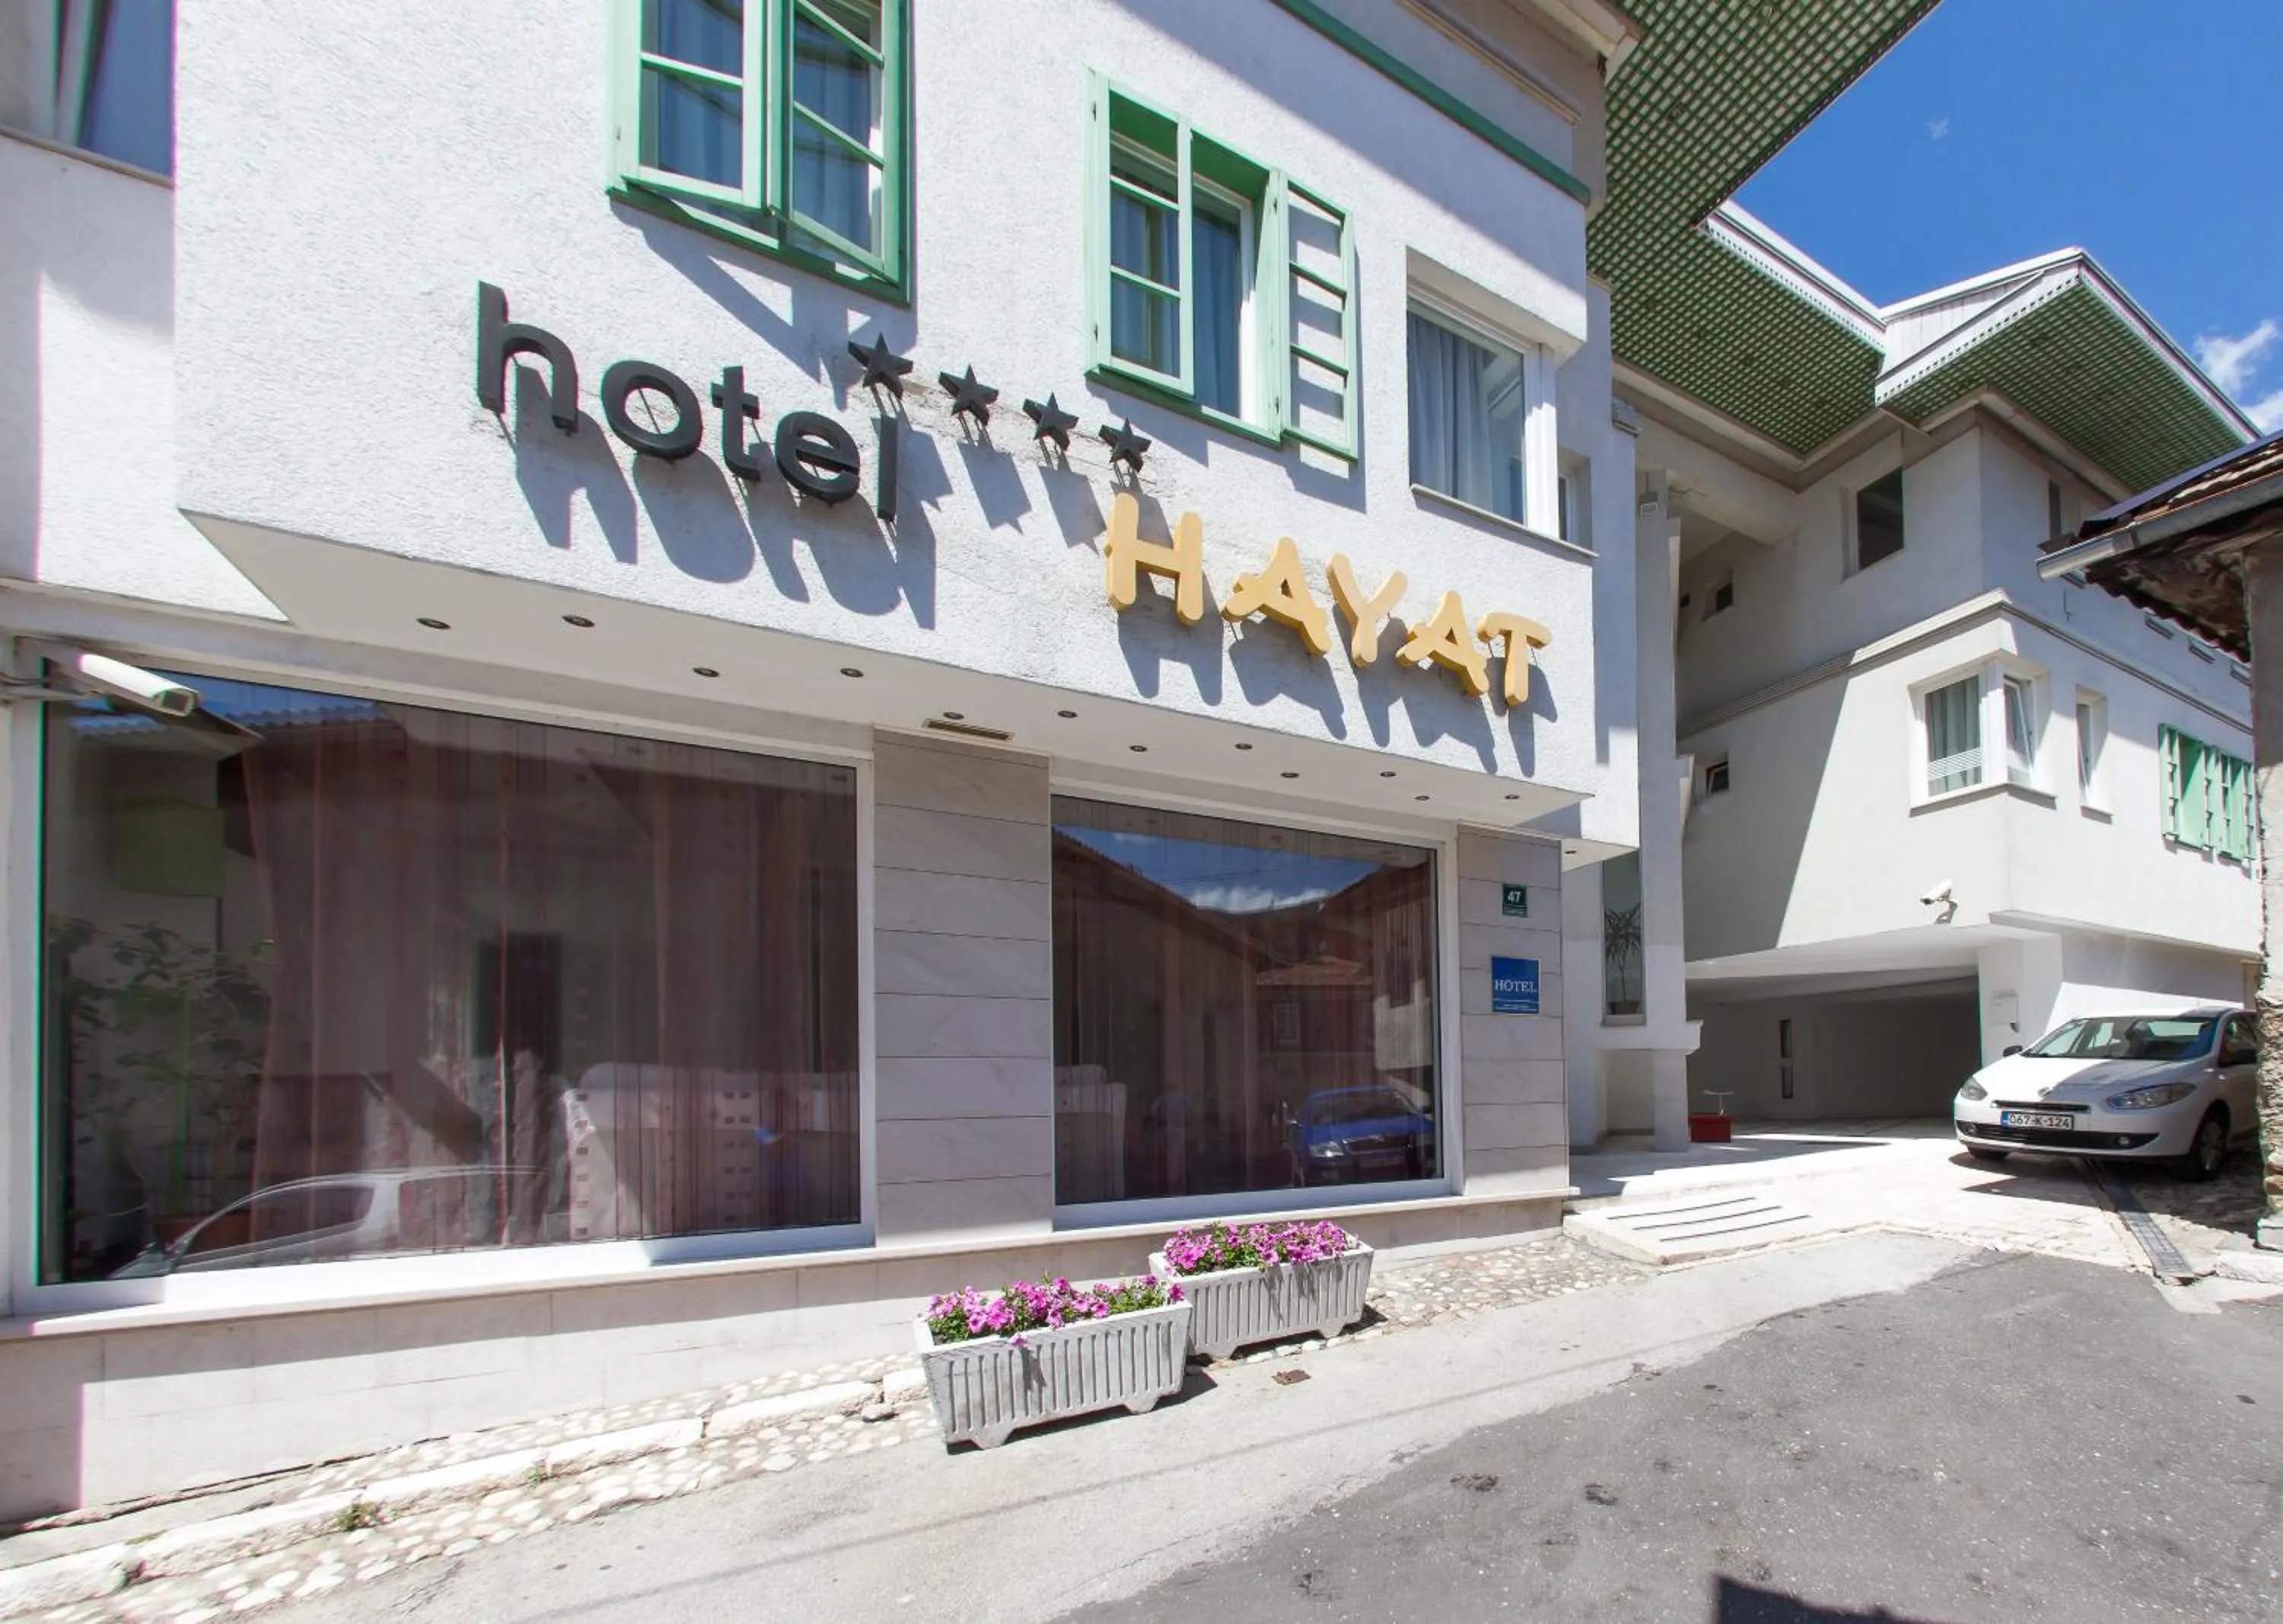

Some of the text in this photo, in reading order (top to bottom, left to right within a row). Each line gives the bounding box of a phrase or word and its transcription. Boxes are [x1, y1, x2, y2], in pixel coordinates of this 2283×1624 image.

[476, 281, 898, 521] hotel
[1105, 492, 1552, 706] HAYAT
[1508, 890, 1521, 903] 47
[1495, 979, 1537, 993] HOTEL
